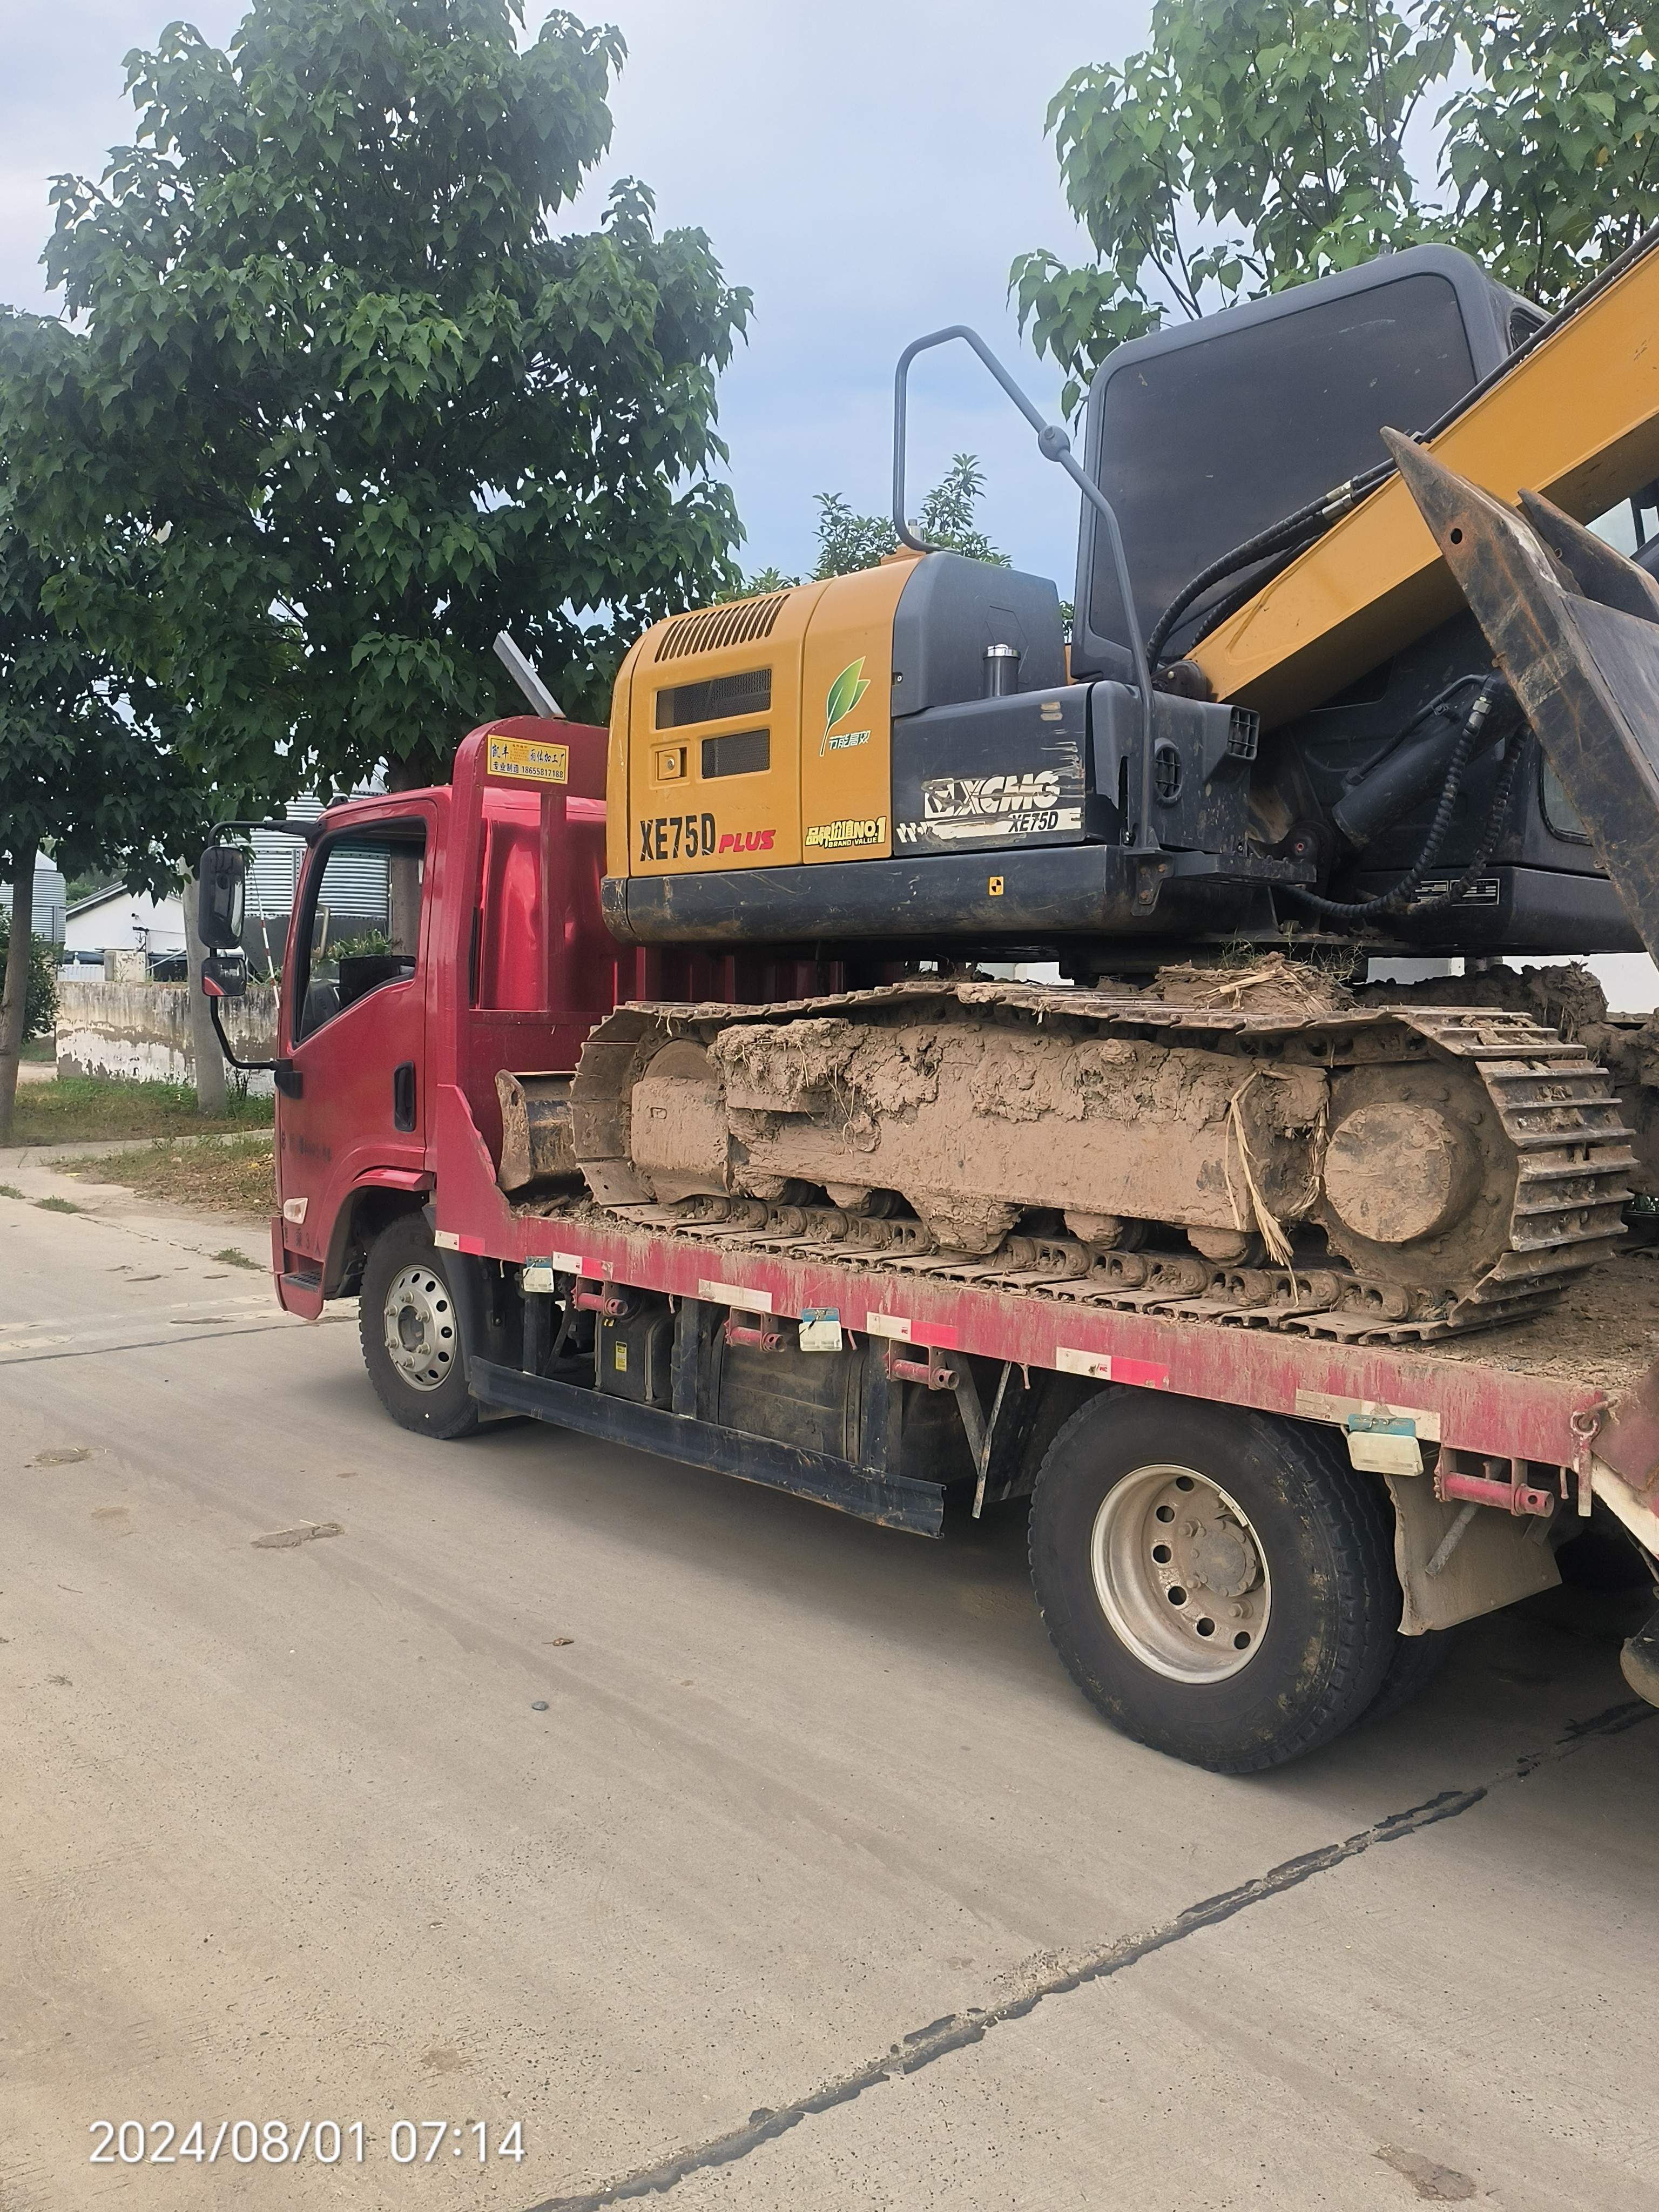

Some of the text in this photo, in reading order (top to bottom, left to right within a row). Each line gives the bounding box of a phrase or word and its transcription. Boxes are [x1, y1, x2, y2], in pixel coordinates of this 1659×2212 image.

[493, 762, 563, 778] 专业制造 18655817188
[954, 771, 1061, 816] XCMG
[1008, 811, 1059, 833] XE75D
[639, 813, 777, 862] XE75D PLUS
[828, 837, 878, 848] BRAND VALUE
